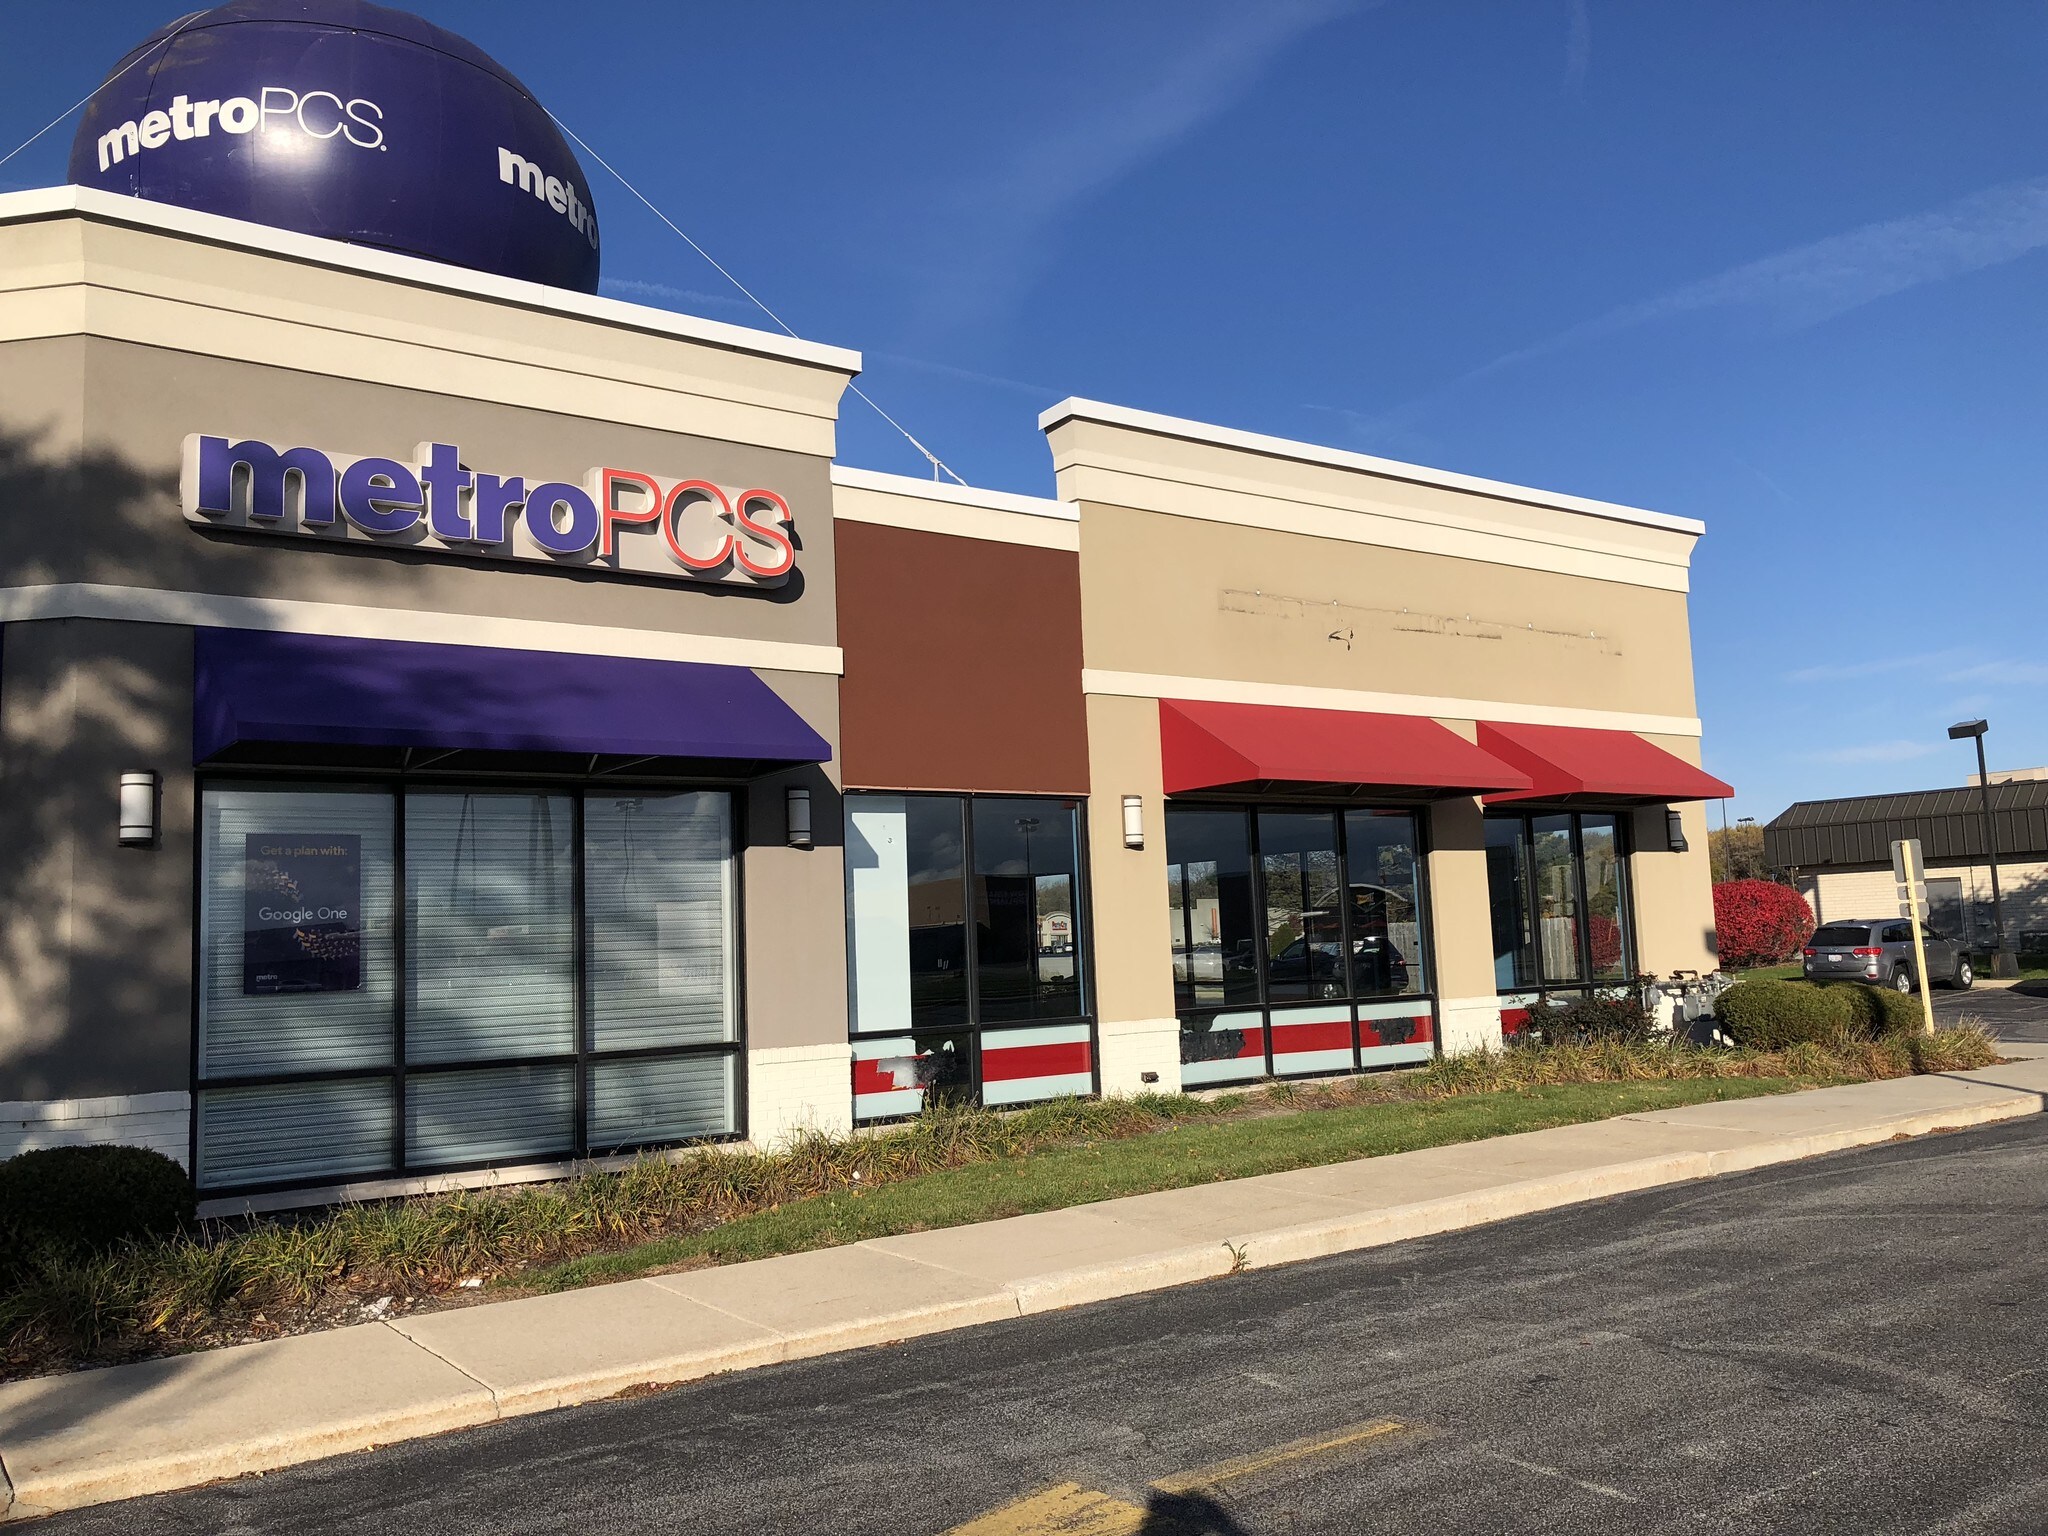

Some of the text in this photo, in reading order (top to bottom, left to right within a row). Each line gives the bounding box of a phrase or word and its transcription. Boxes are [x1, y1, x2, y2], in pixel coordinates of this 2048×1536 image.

[198, 435, 795, 577] metroPCS
[260, 845, 348, 858] Get a plan with:
[258, 906, 348, 923] Google One
